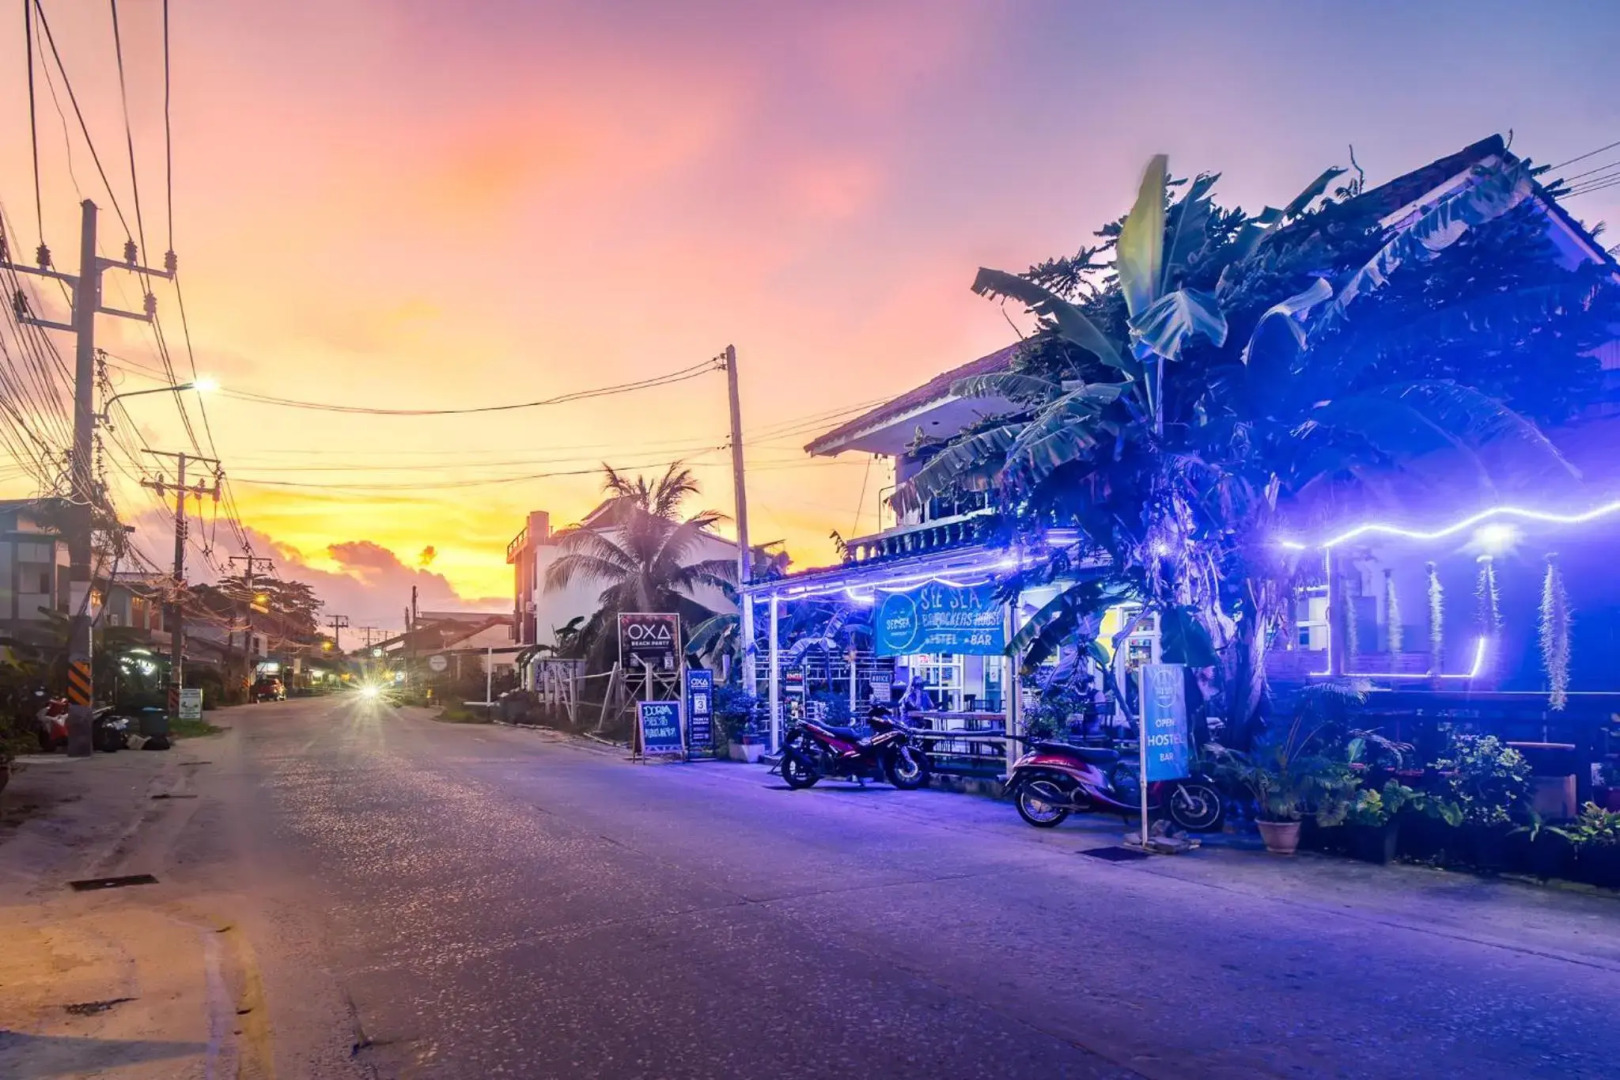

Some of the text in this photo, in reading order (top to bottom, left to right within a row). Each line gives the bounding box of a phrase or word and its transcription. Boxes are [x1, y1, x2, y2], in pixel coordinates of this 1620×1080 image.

[970, 634, 992, 645] BAR
[1155, 719, 1175, 728] OPEN
[1147, 734, 1184, 746] HOSTEL
[1160, 752, 1174, 762] BAR
